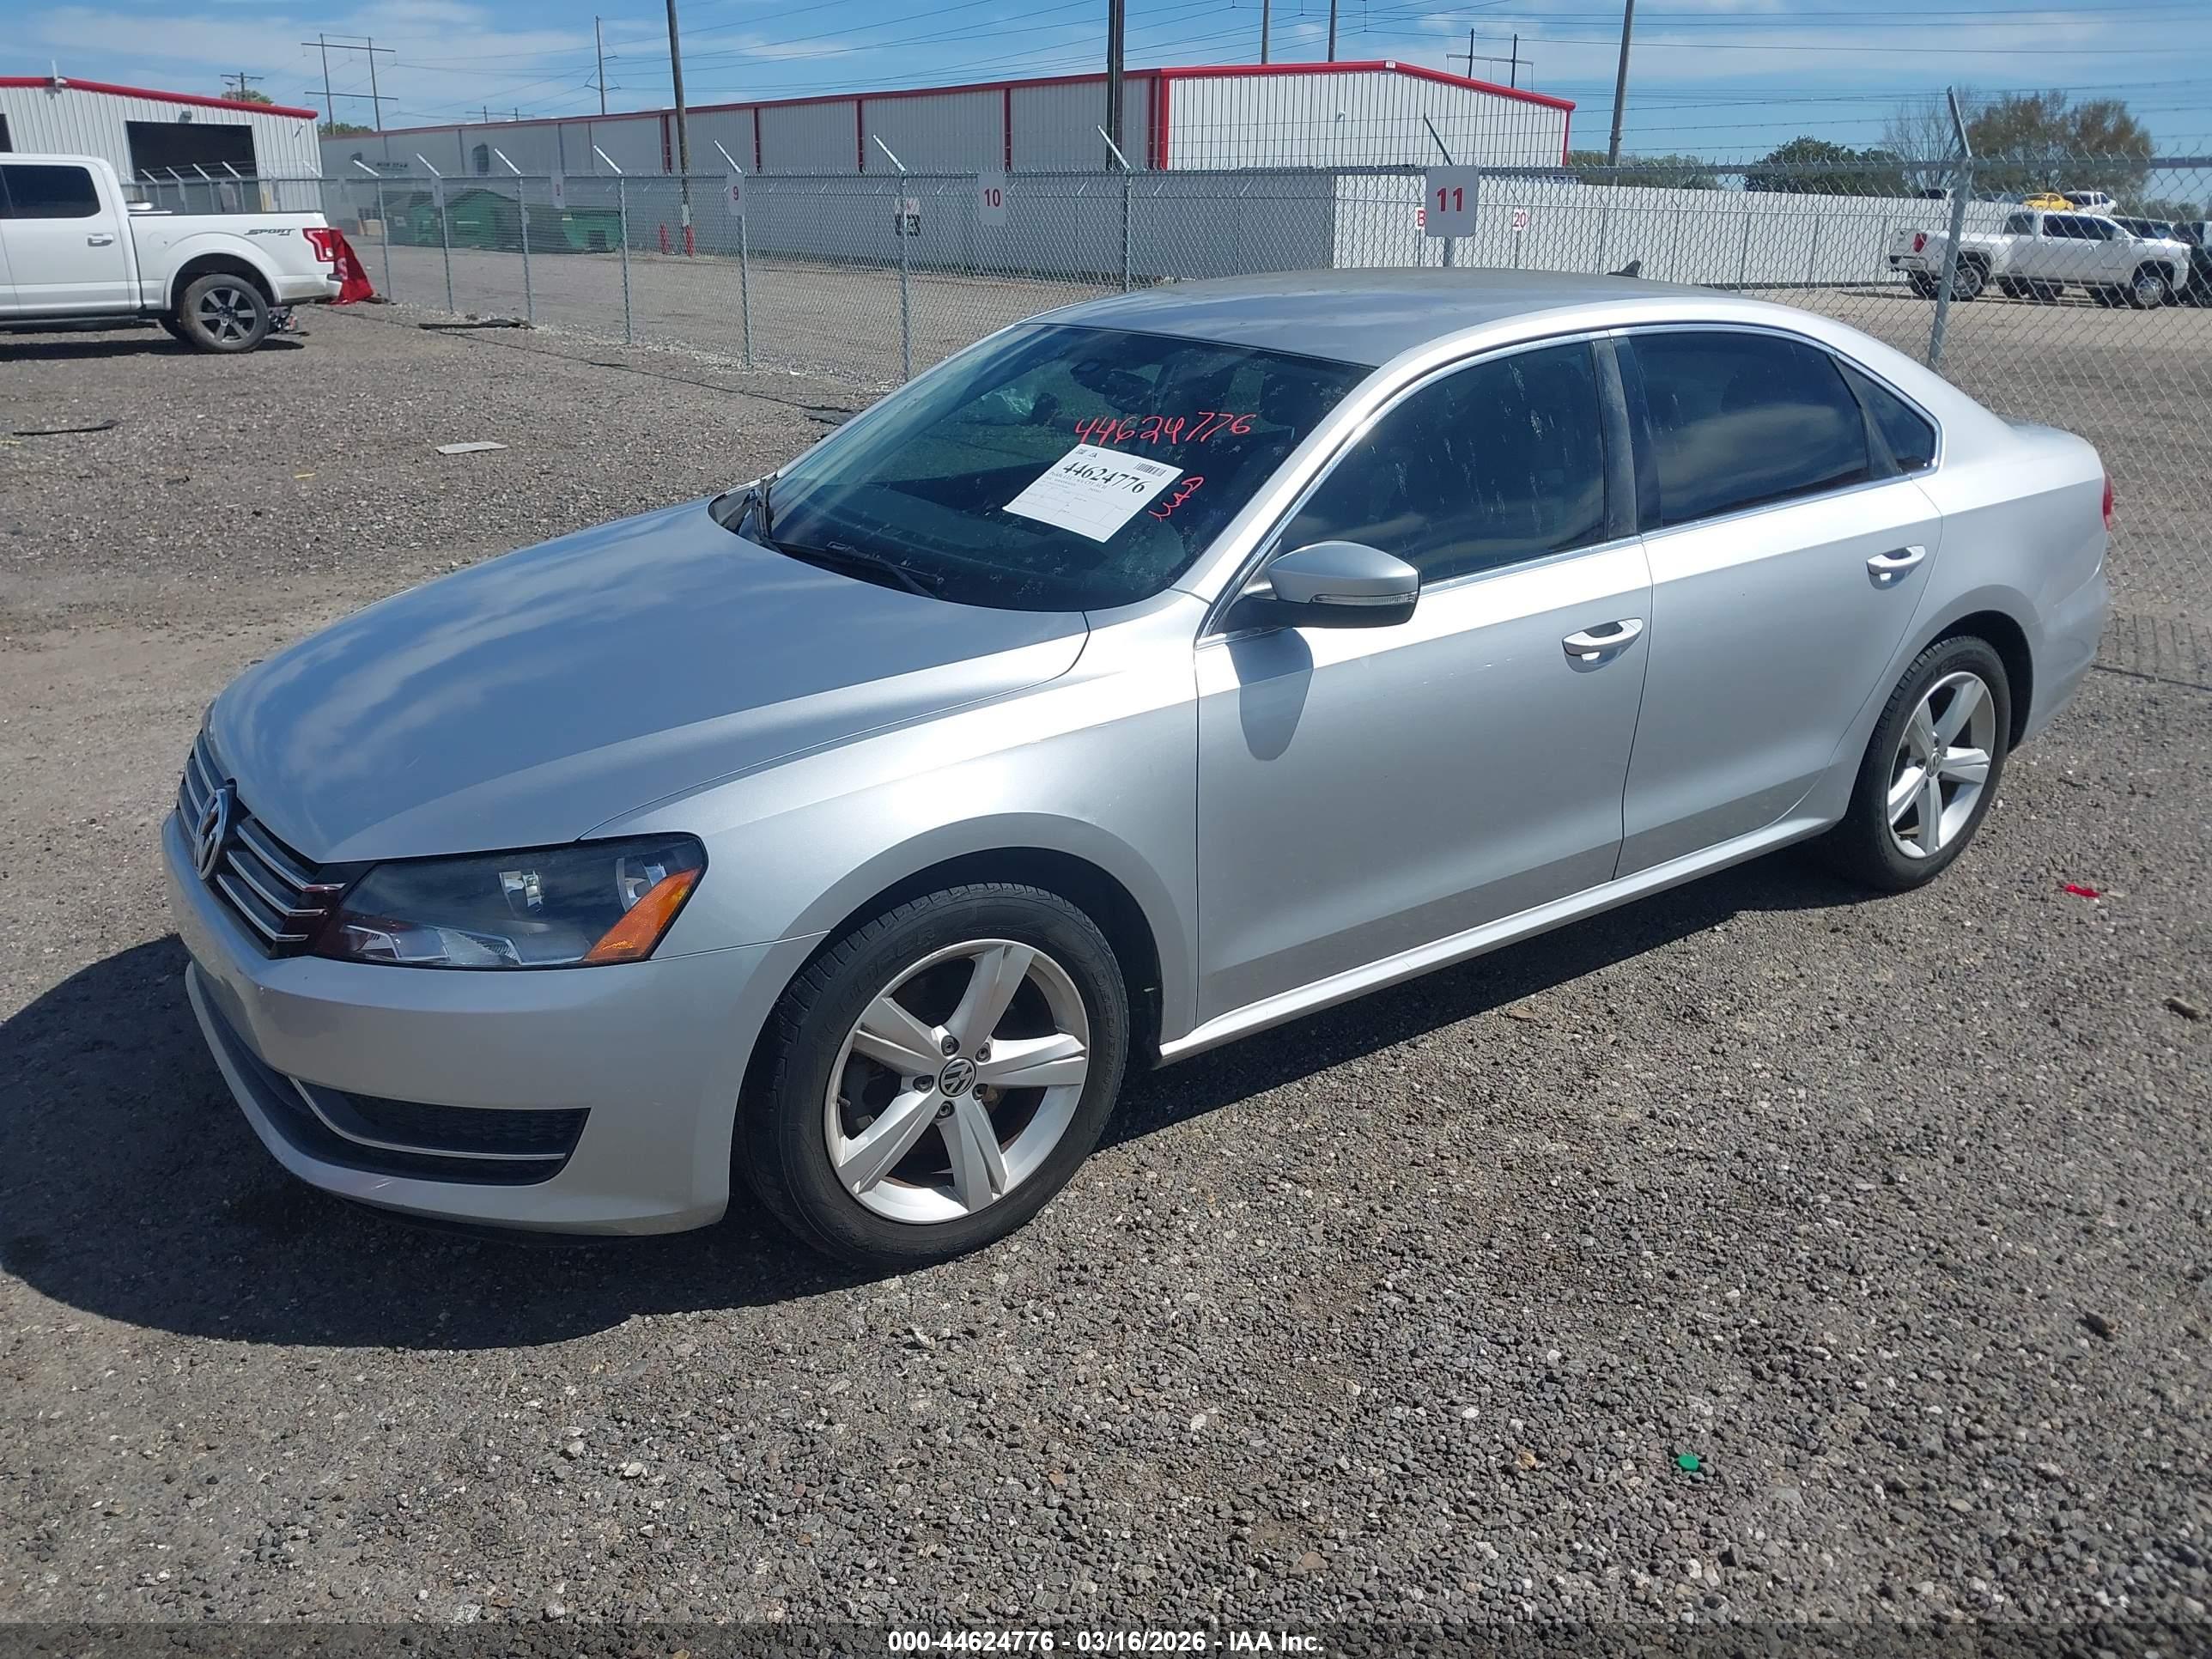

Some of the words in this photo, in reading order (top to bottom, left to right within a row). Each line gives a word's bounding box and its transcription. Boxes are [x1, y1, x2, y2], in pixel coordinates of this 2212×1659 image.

[732, 185, 739, 201] 9
[984, 188, 1001, 208] 10
[1436, 186, 1464, 212] 11
[1511, 211, 1527, 228] 20
[1075, 411, 1256, 447] 44624776
[1063, 461, 1152, 494] 44624776
